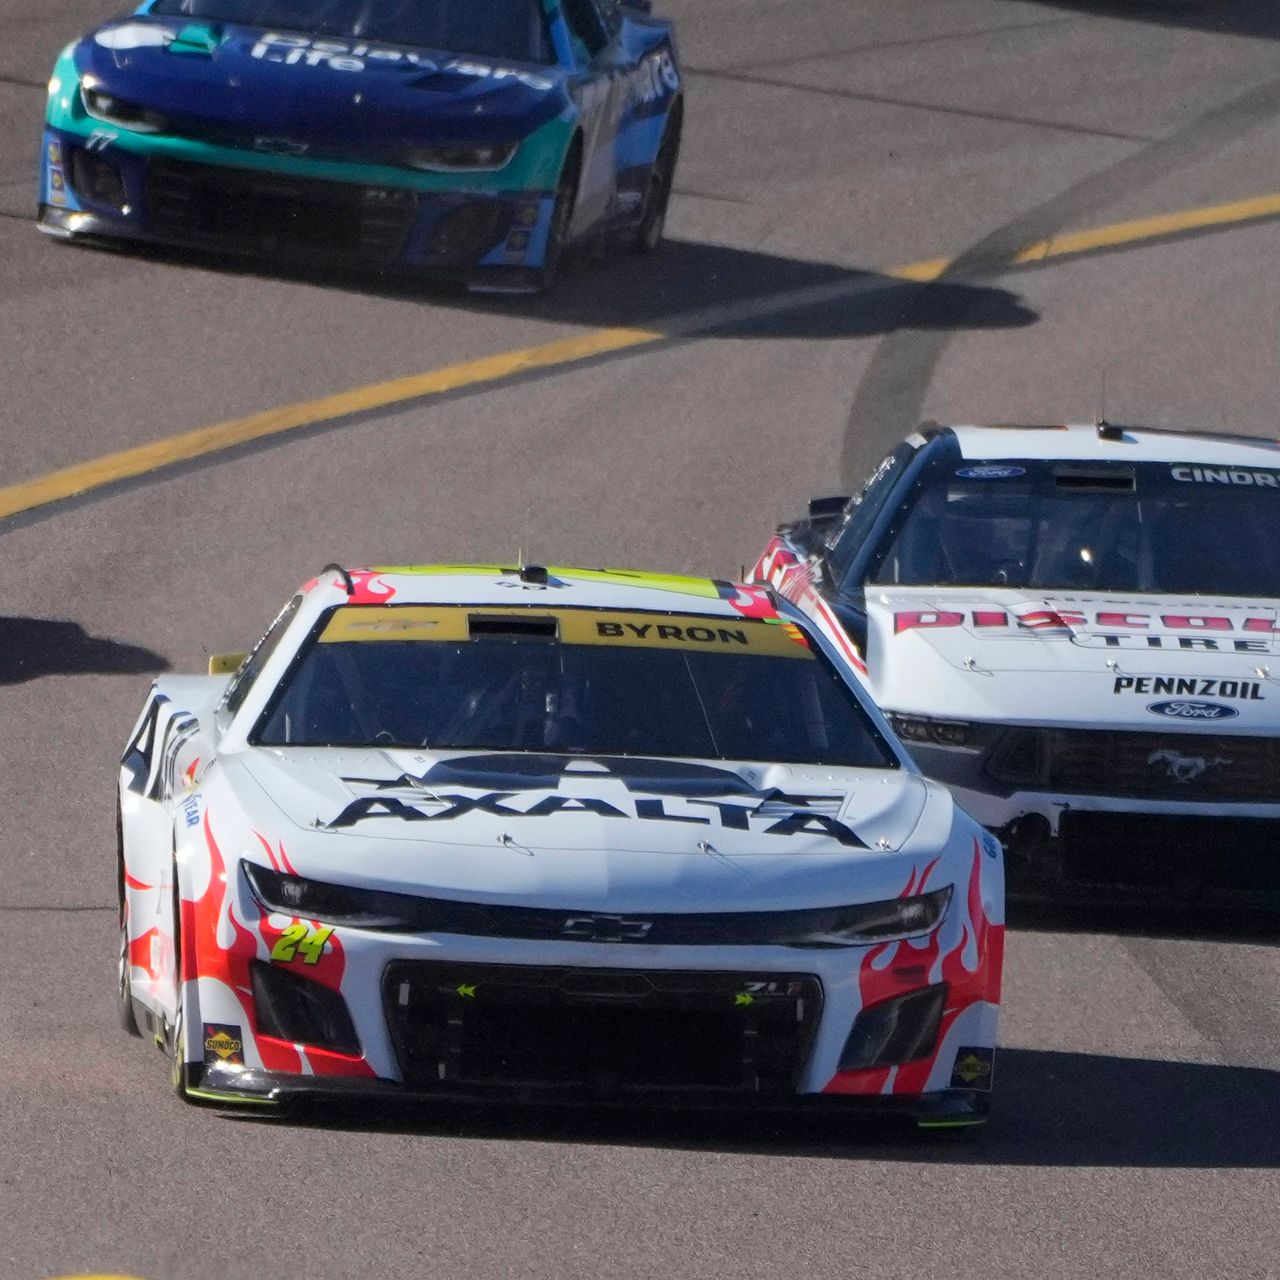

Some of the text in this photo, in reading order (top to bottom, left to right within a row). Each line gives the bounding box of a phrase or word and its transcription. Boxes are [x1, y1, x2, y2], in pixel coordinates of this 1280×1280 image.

[85, 127, 119, 151] 77
[595, 621, 750, 646] BYRON
[1091, 634, 1271, 654] TIRE
[1113, 676, 1267, 701] PENNZOIL
[1160, 702, 1227, 721] Ford
[325, 792, 873, 850] AXALTA
[271, 923, 336, 964] 24
[206, 1038, 241, 1052] SUNOCO
